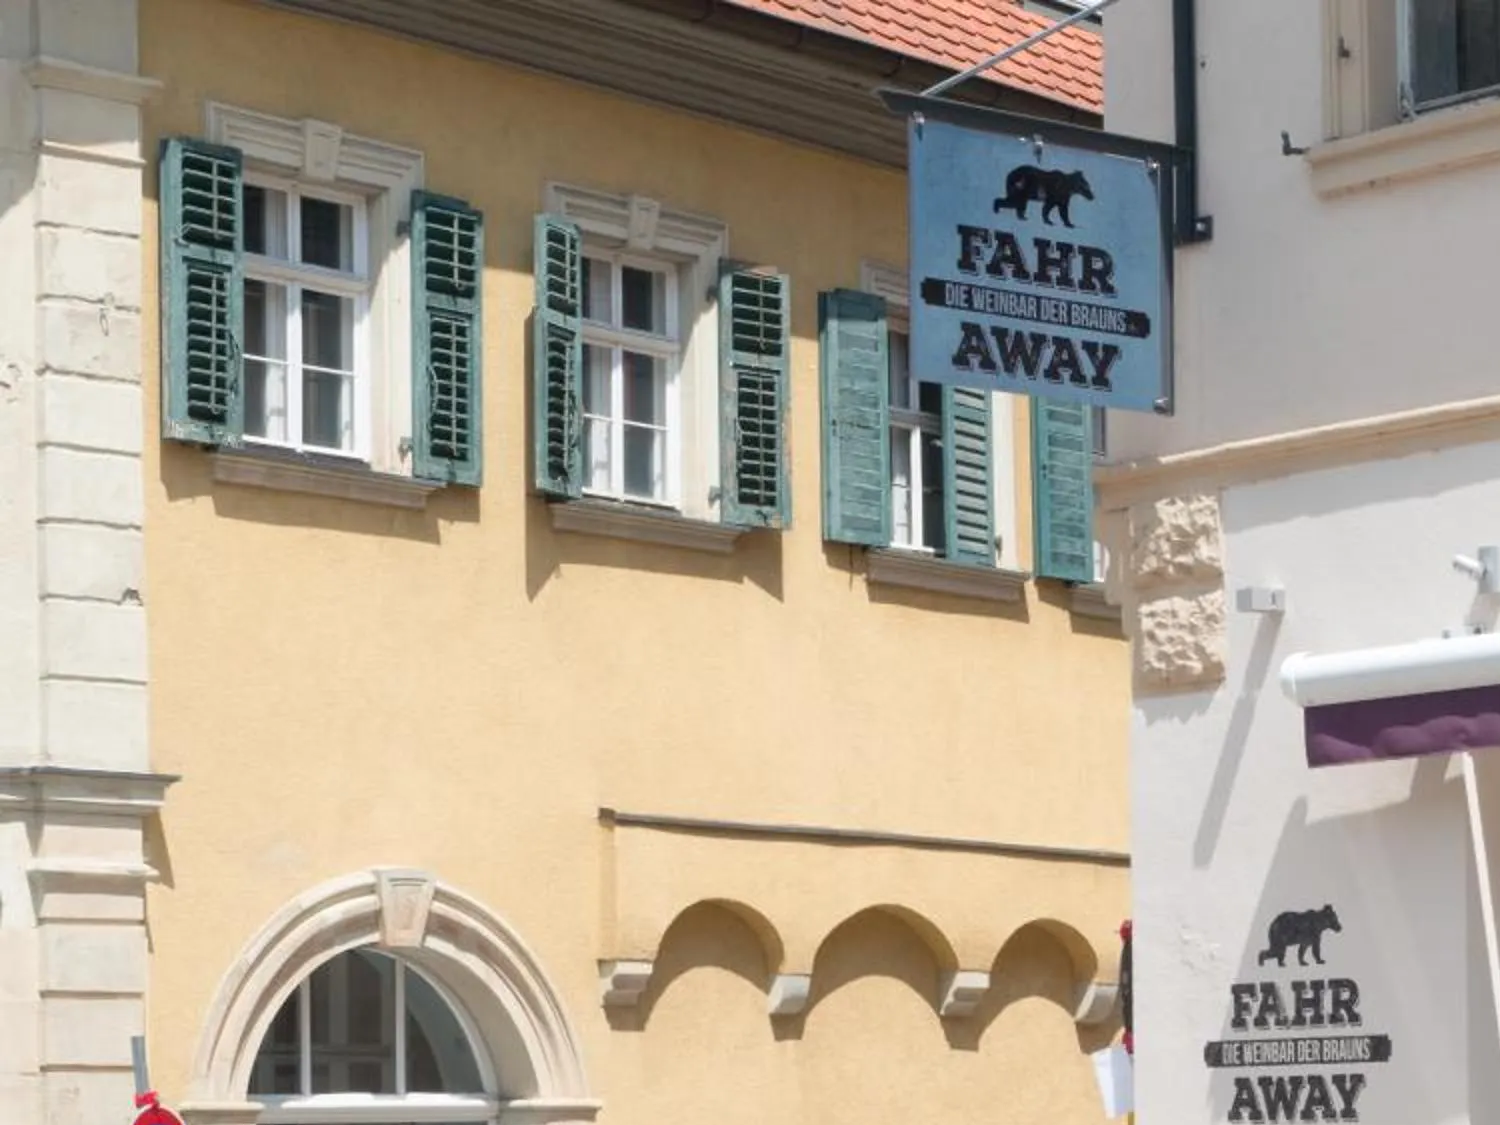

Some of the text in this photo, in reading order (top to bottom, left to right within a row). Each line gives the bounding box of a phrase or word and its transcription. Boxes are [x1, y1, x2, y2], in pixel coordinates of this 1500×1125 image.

[956, 224, 1118, 298] FAHR
[944, 282, 1128, 333] DIE WEINBAR DER BRAUNS
[952, 321, 1124, 392] AWAY
[1230, 978, 1363, 1030] FAHR
[1221, 1037, 1371, 1065] DIE WEINBAR DER BRAUNS
[1228, 1073, 1367, 1124] AWAY
